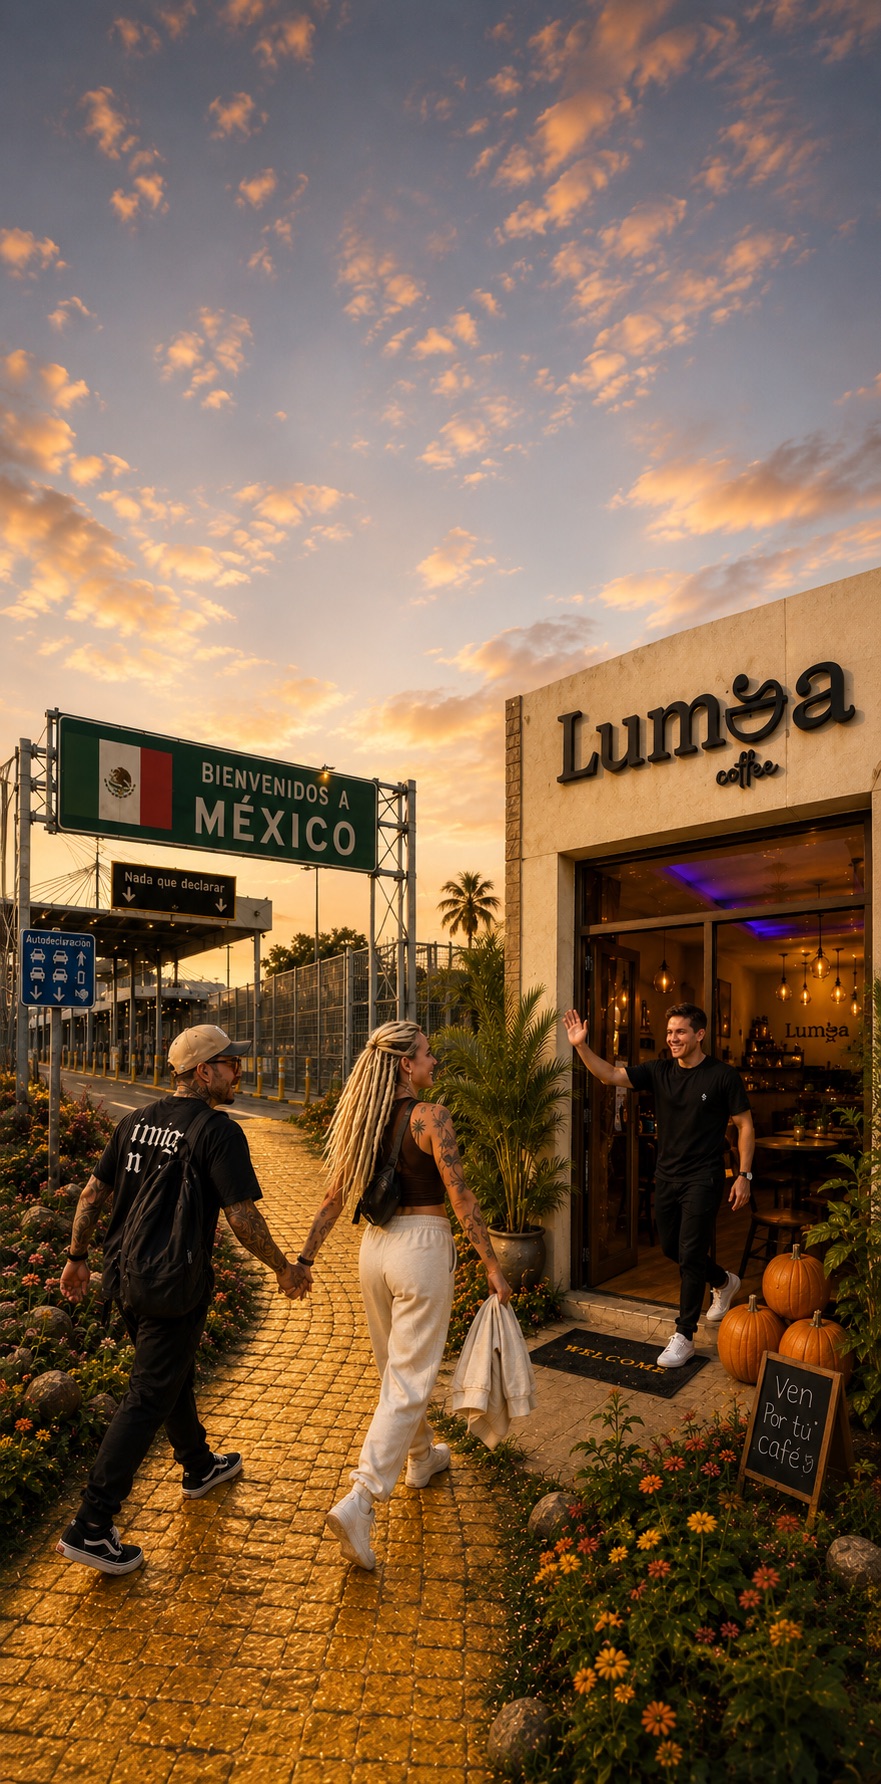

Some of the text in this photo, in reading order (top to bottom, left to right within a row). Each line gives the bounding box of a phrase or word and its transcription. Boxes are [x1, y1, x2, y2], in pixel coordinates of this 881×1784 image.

[201, 761, 350, 810] BIENVENIDOS A
[716, 749, 779, 789] coffee
[194, 794, 356, 856] MÉXICO
[124, 871, 225, 893] Nada que declarar
[564, 1344, 669, 1374] WELCOME
[775, 1375, 813, 1408] Ven
